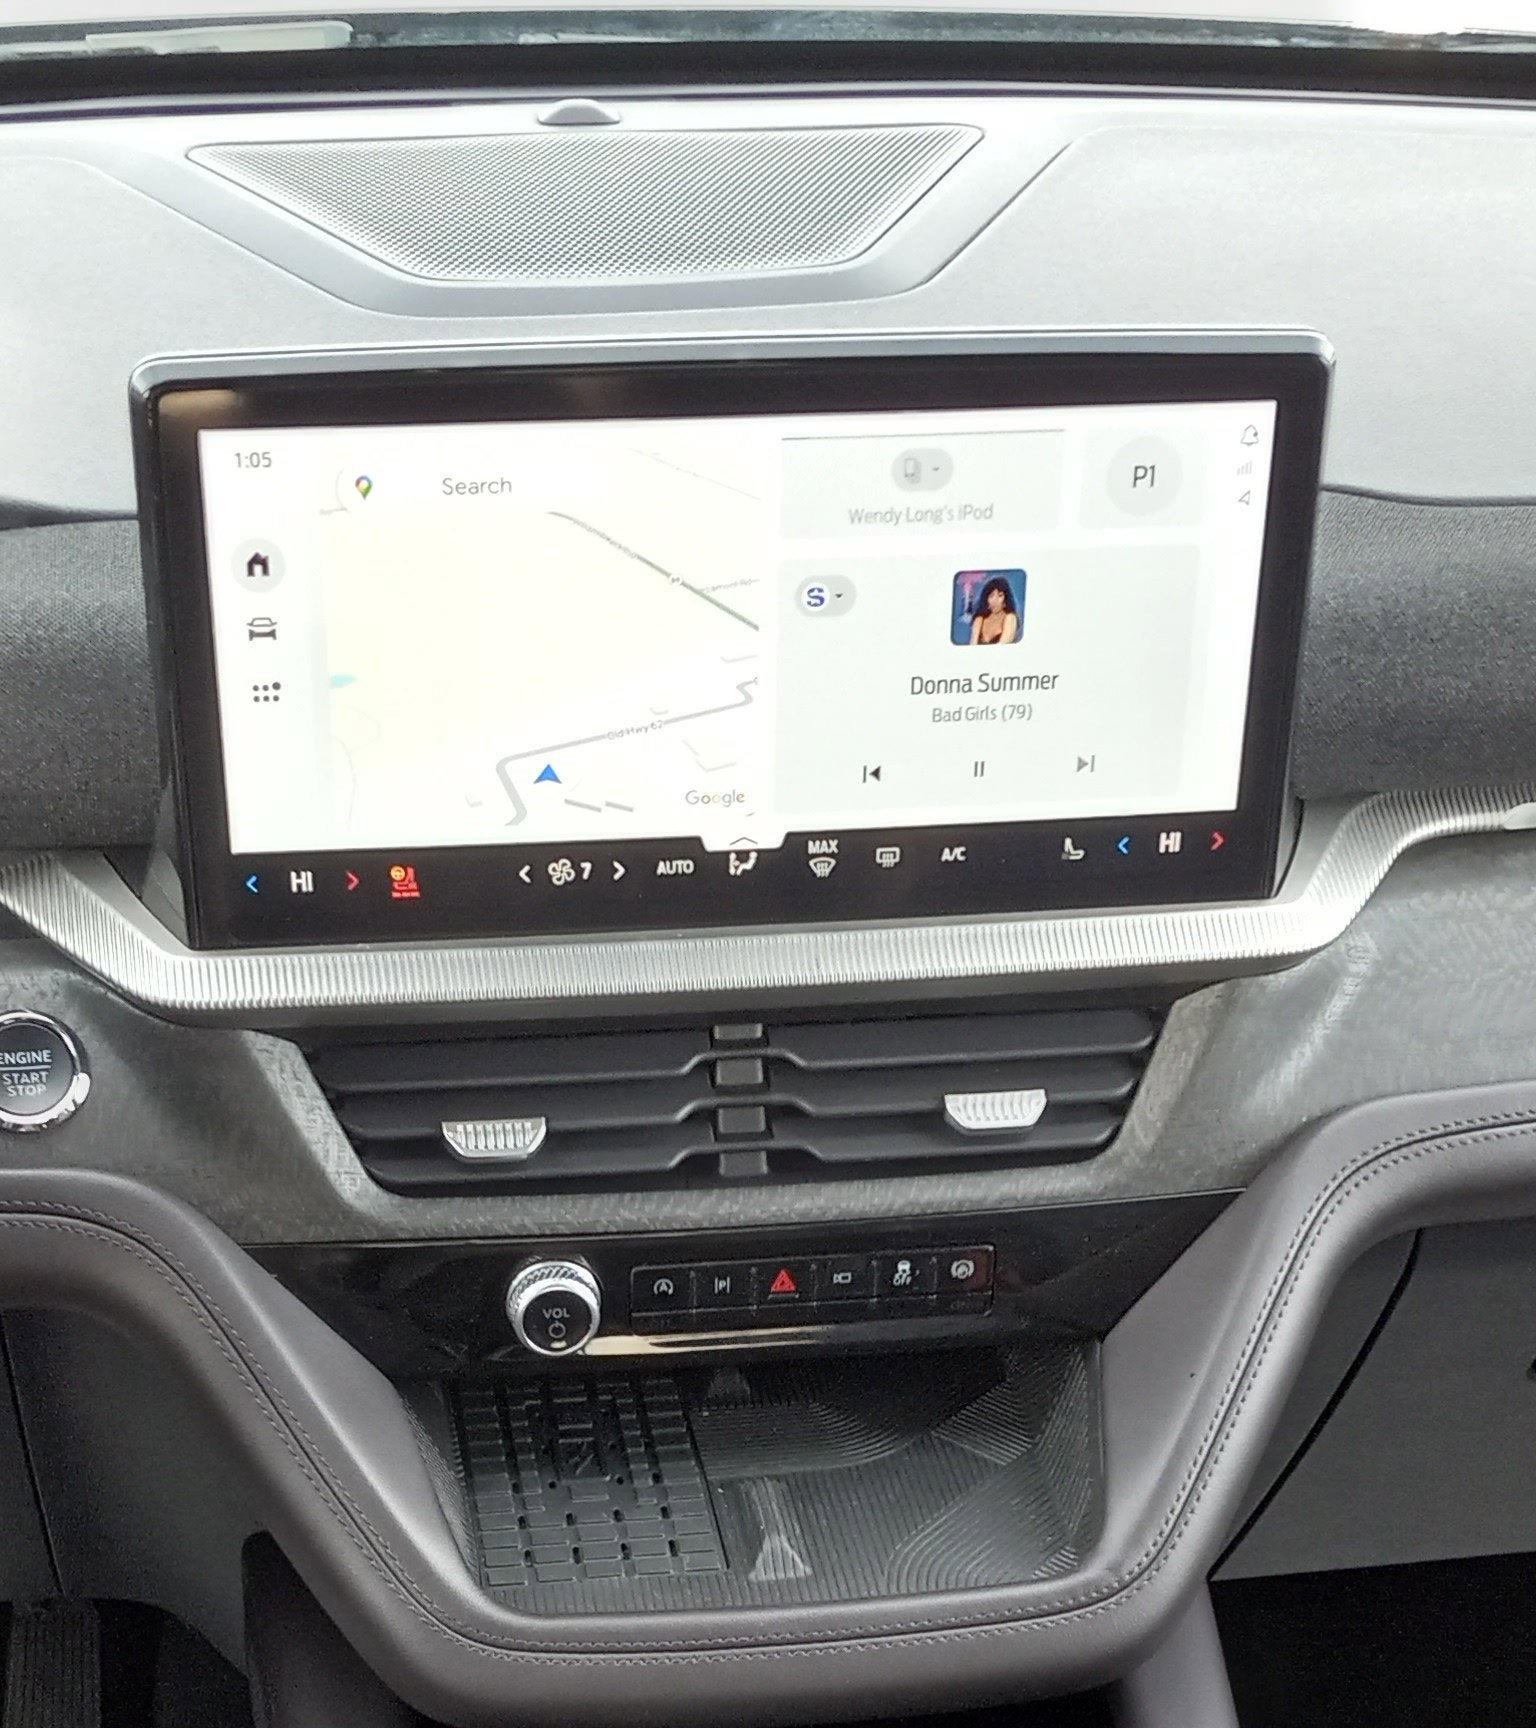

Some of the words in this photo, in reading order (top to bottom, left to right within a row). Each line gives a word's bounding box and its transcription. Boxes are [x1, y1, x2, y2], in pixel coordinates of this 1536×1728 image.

[234, 451, 272, 469] 1:05
[1132, 465, 1156, 488] P1
[442, 476, 512, 496] Search
[848, 508, 902, 526] Wendy
[905, 506, 954, 525] Long's
[957, 503, 994, 520] iPod
[910, 676, 973, 696] Donna
[977, 672, 1059, 693] Summer
[932, 707, 962, 723] Bad
[965, 706, 997, 721] Girls
[1001, 703, 1033, 721] (79)
[685, 789, 745, 808] Google
[807, 840, 839, 853] MAX
[1159, 832, 1182, 853] HI
[941, 846, 967, 862] A/C
[579, 862, 592, 880] 7
[656, 860, 694, 876] AUTO
[290, 871, 314, 893] HI
[2, 1071, 49, 1085] START
[6, 1084, 47, 1097] STOP
[542, 1307, 571, 1319] VOL
